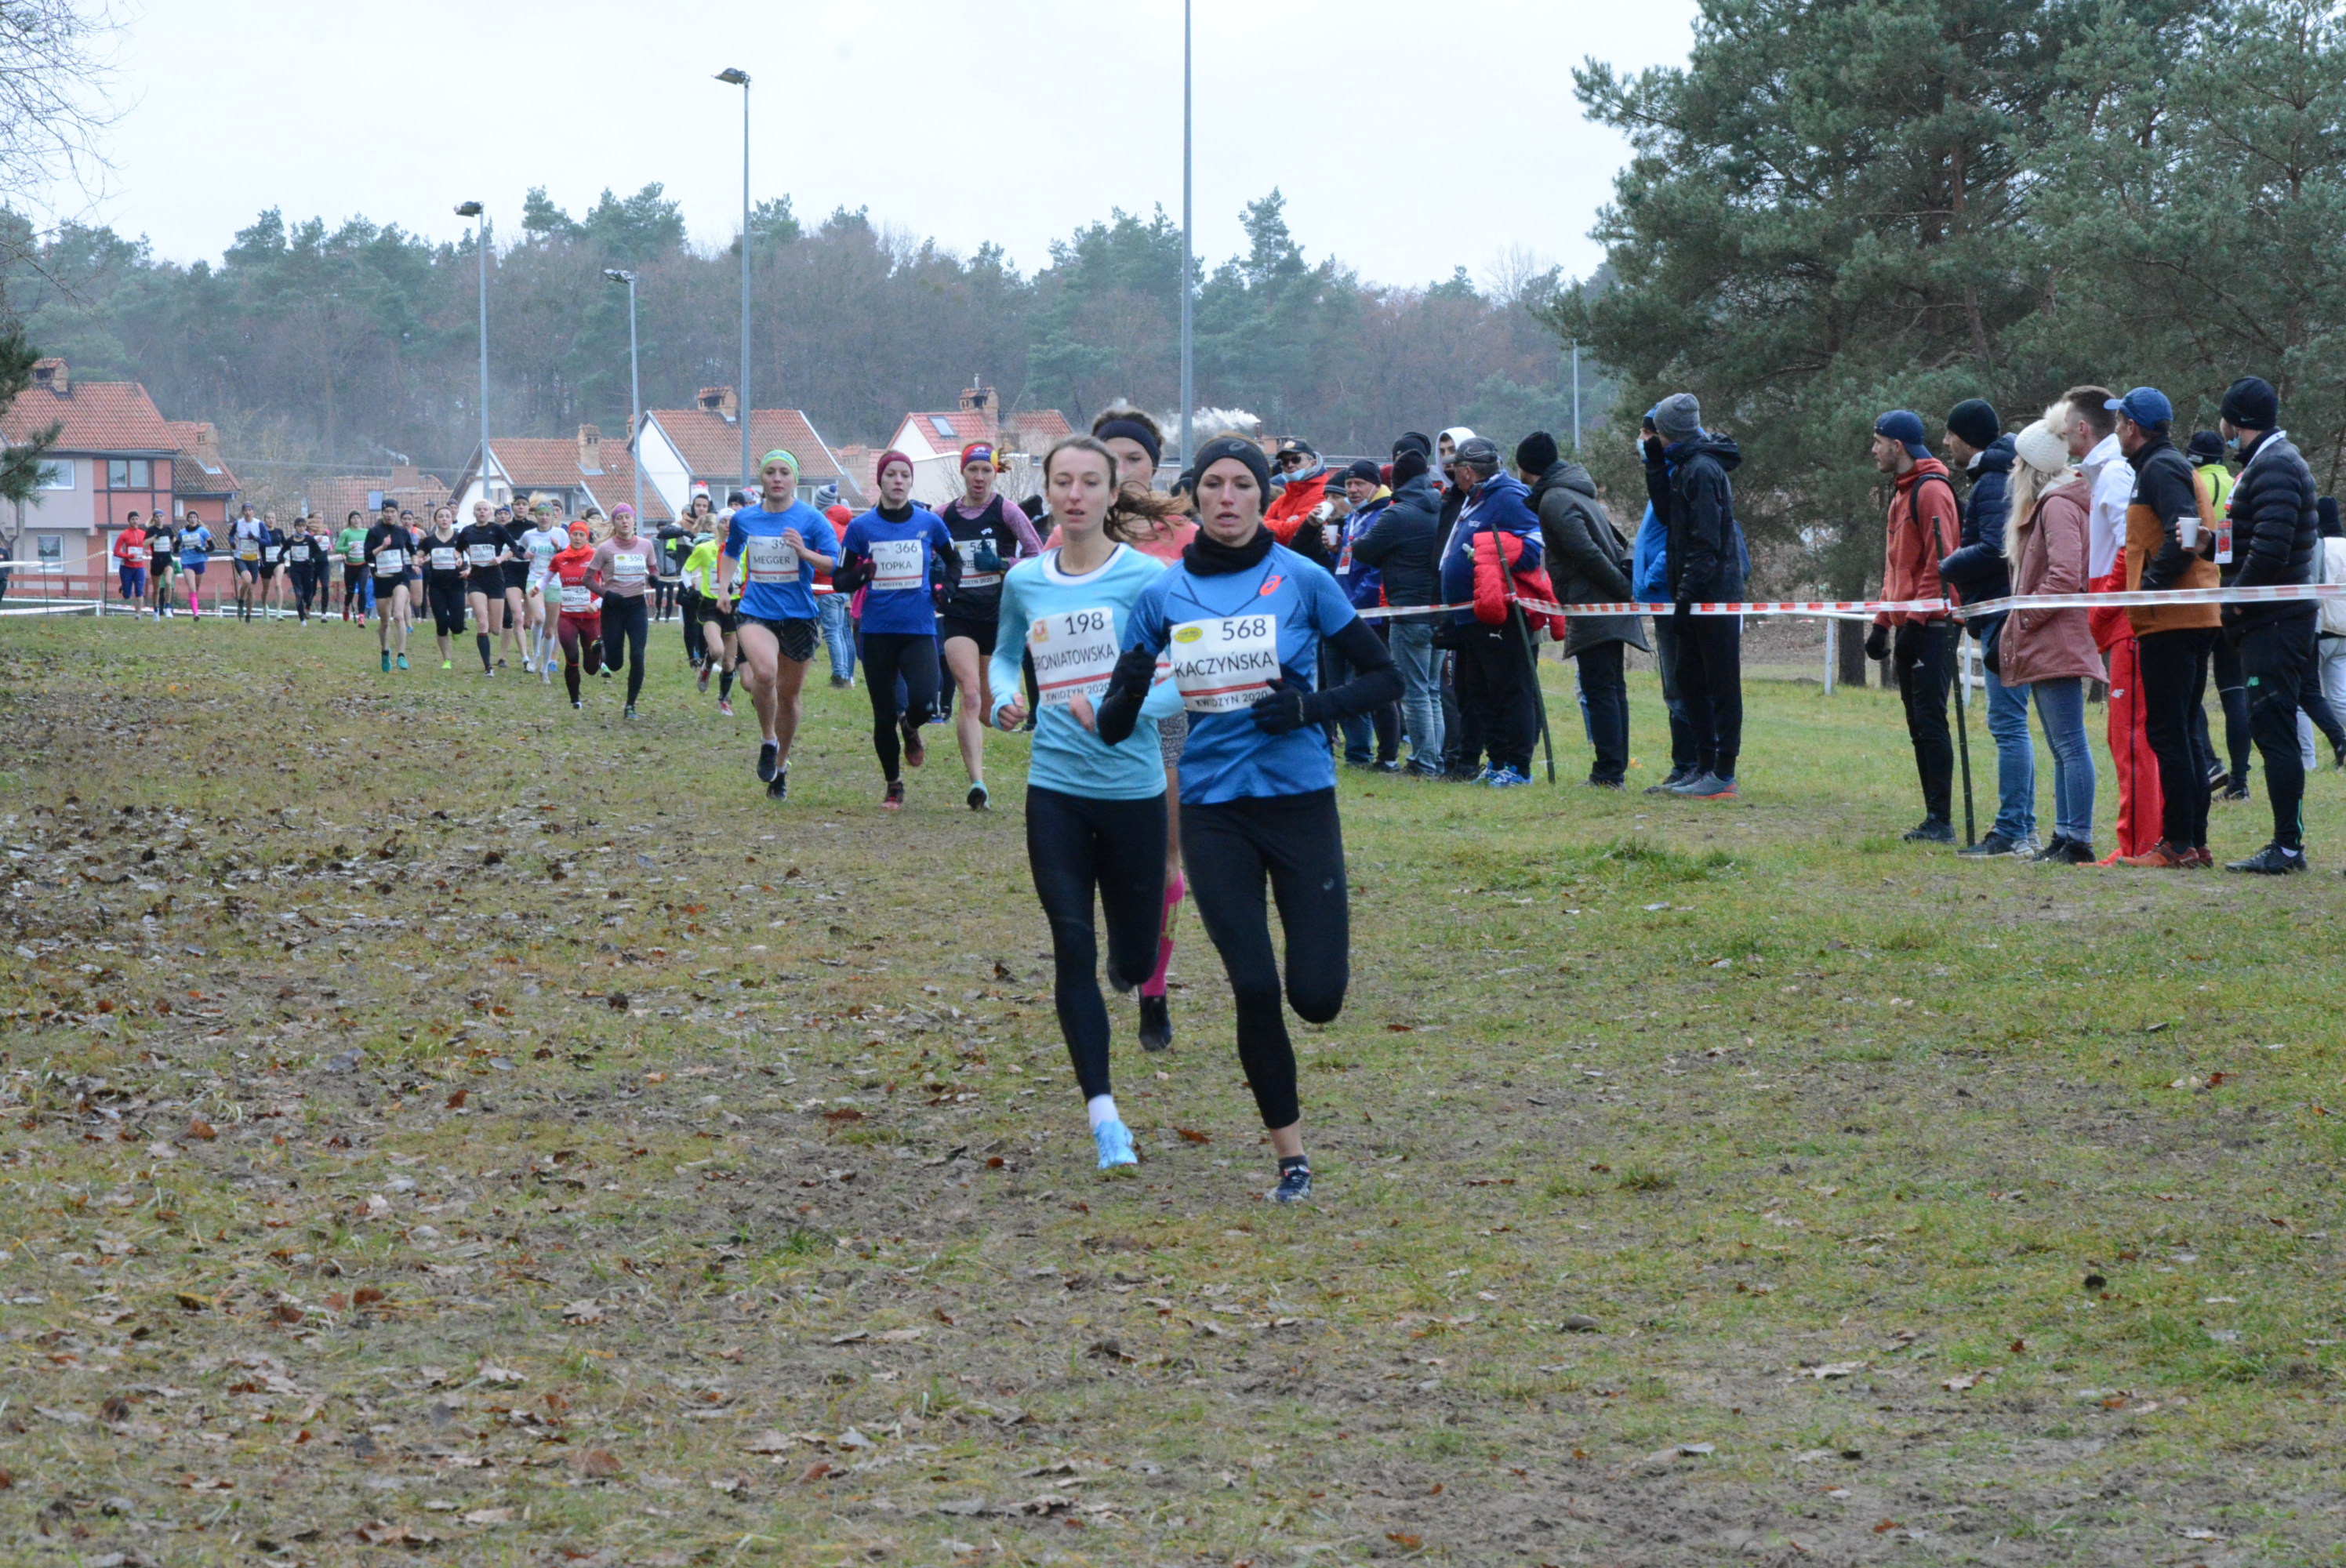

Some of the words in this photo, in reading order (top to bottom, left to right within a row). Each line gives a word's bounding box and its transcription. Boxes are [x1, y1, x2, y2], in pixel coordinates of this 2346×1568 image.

[895, 543, 918, 554] 366
[753, 555, 791, 564] MEGGER
[880, 560, 913, 571] TOPKA
[1065, 612, 1105, 637] 198
[1222, 618, 1267, 641] 568
[1175, 652, 1275, 678] KACZYŃSKA
